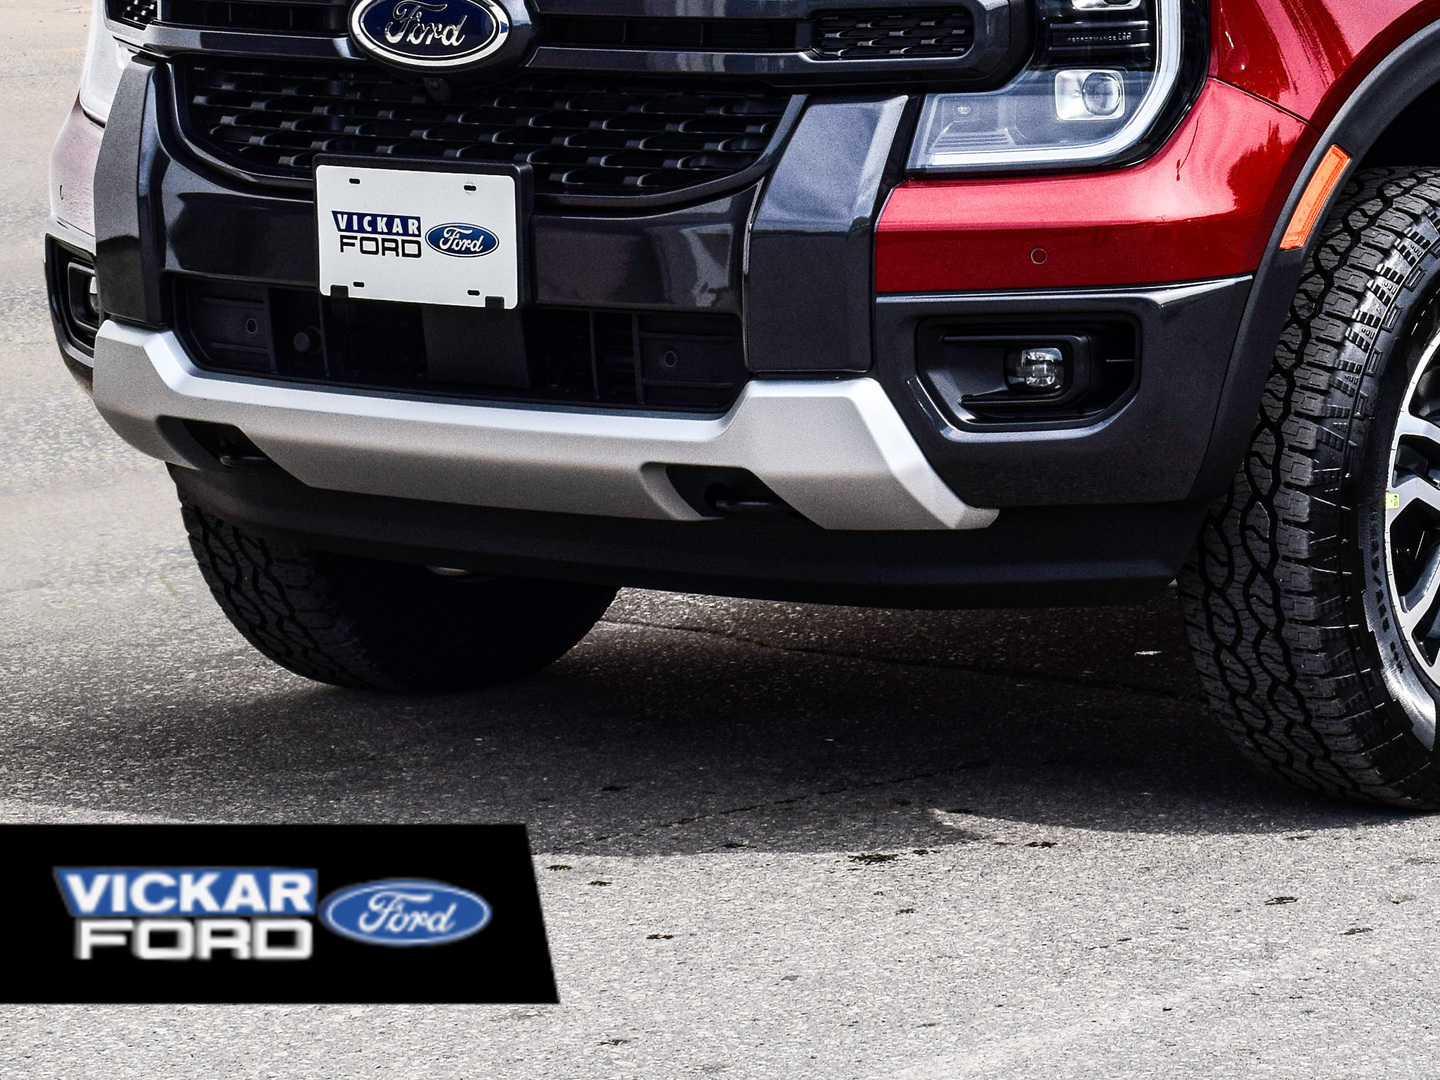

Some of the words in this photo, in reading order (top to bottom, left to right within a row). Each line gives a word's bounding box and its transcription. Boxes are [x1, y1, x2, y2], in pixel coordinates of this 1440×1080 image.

[384, 0, 468, 47] Ford
[337, 213, 420, 236] VICKAR
[339, 235, 422, 259] FORD
[439, 228, 484, 253] Ford
